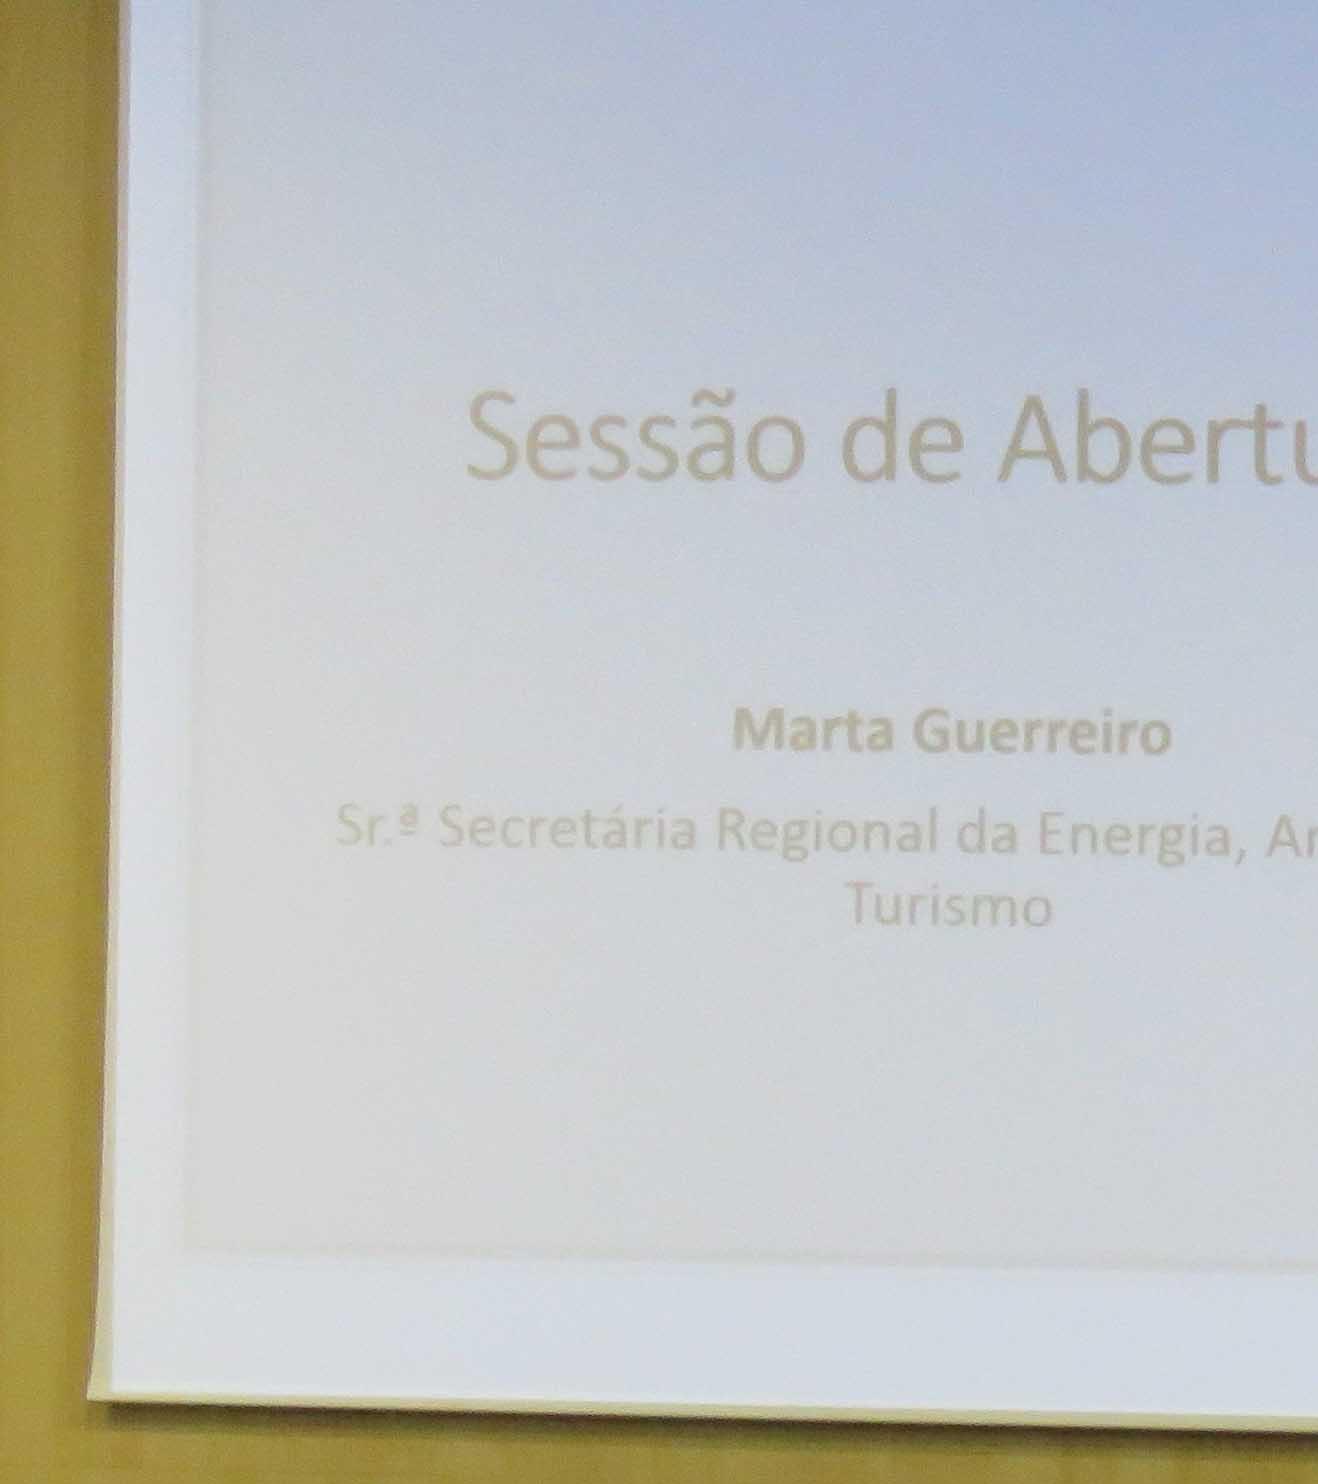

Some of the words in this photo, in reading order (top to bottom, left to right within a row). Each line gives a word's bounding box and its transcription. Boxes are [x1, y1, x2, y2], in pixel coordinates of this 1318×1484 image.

[465, 387, 809, 485] Sessão
[839, 385, 965, 486] de
[730, 706, 897, 754] Marta
[912, 706, 1174, 757] Guerreiro
[438, 801, 697, 854] Secretária
[714, 806, 939, 865] Regional
[956, 805, 1023, 857] da
[1038, 810, 1247, 870] Energia,
[845, 881, 1056, 929] Turismo
